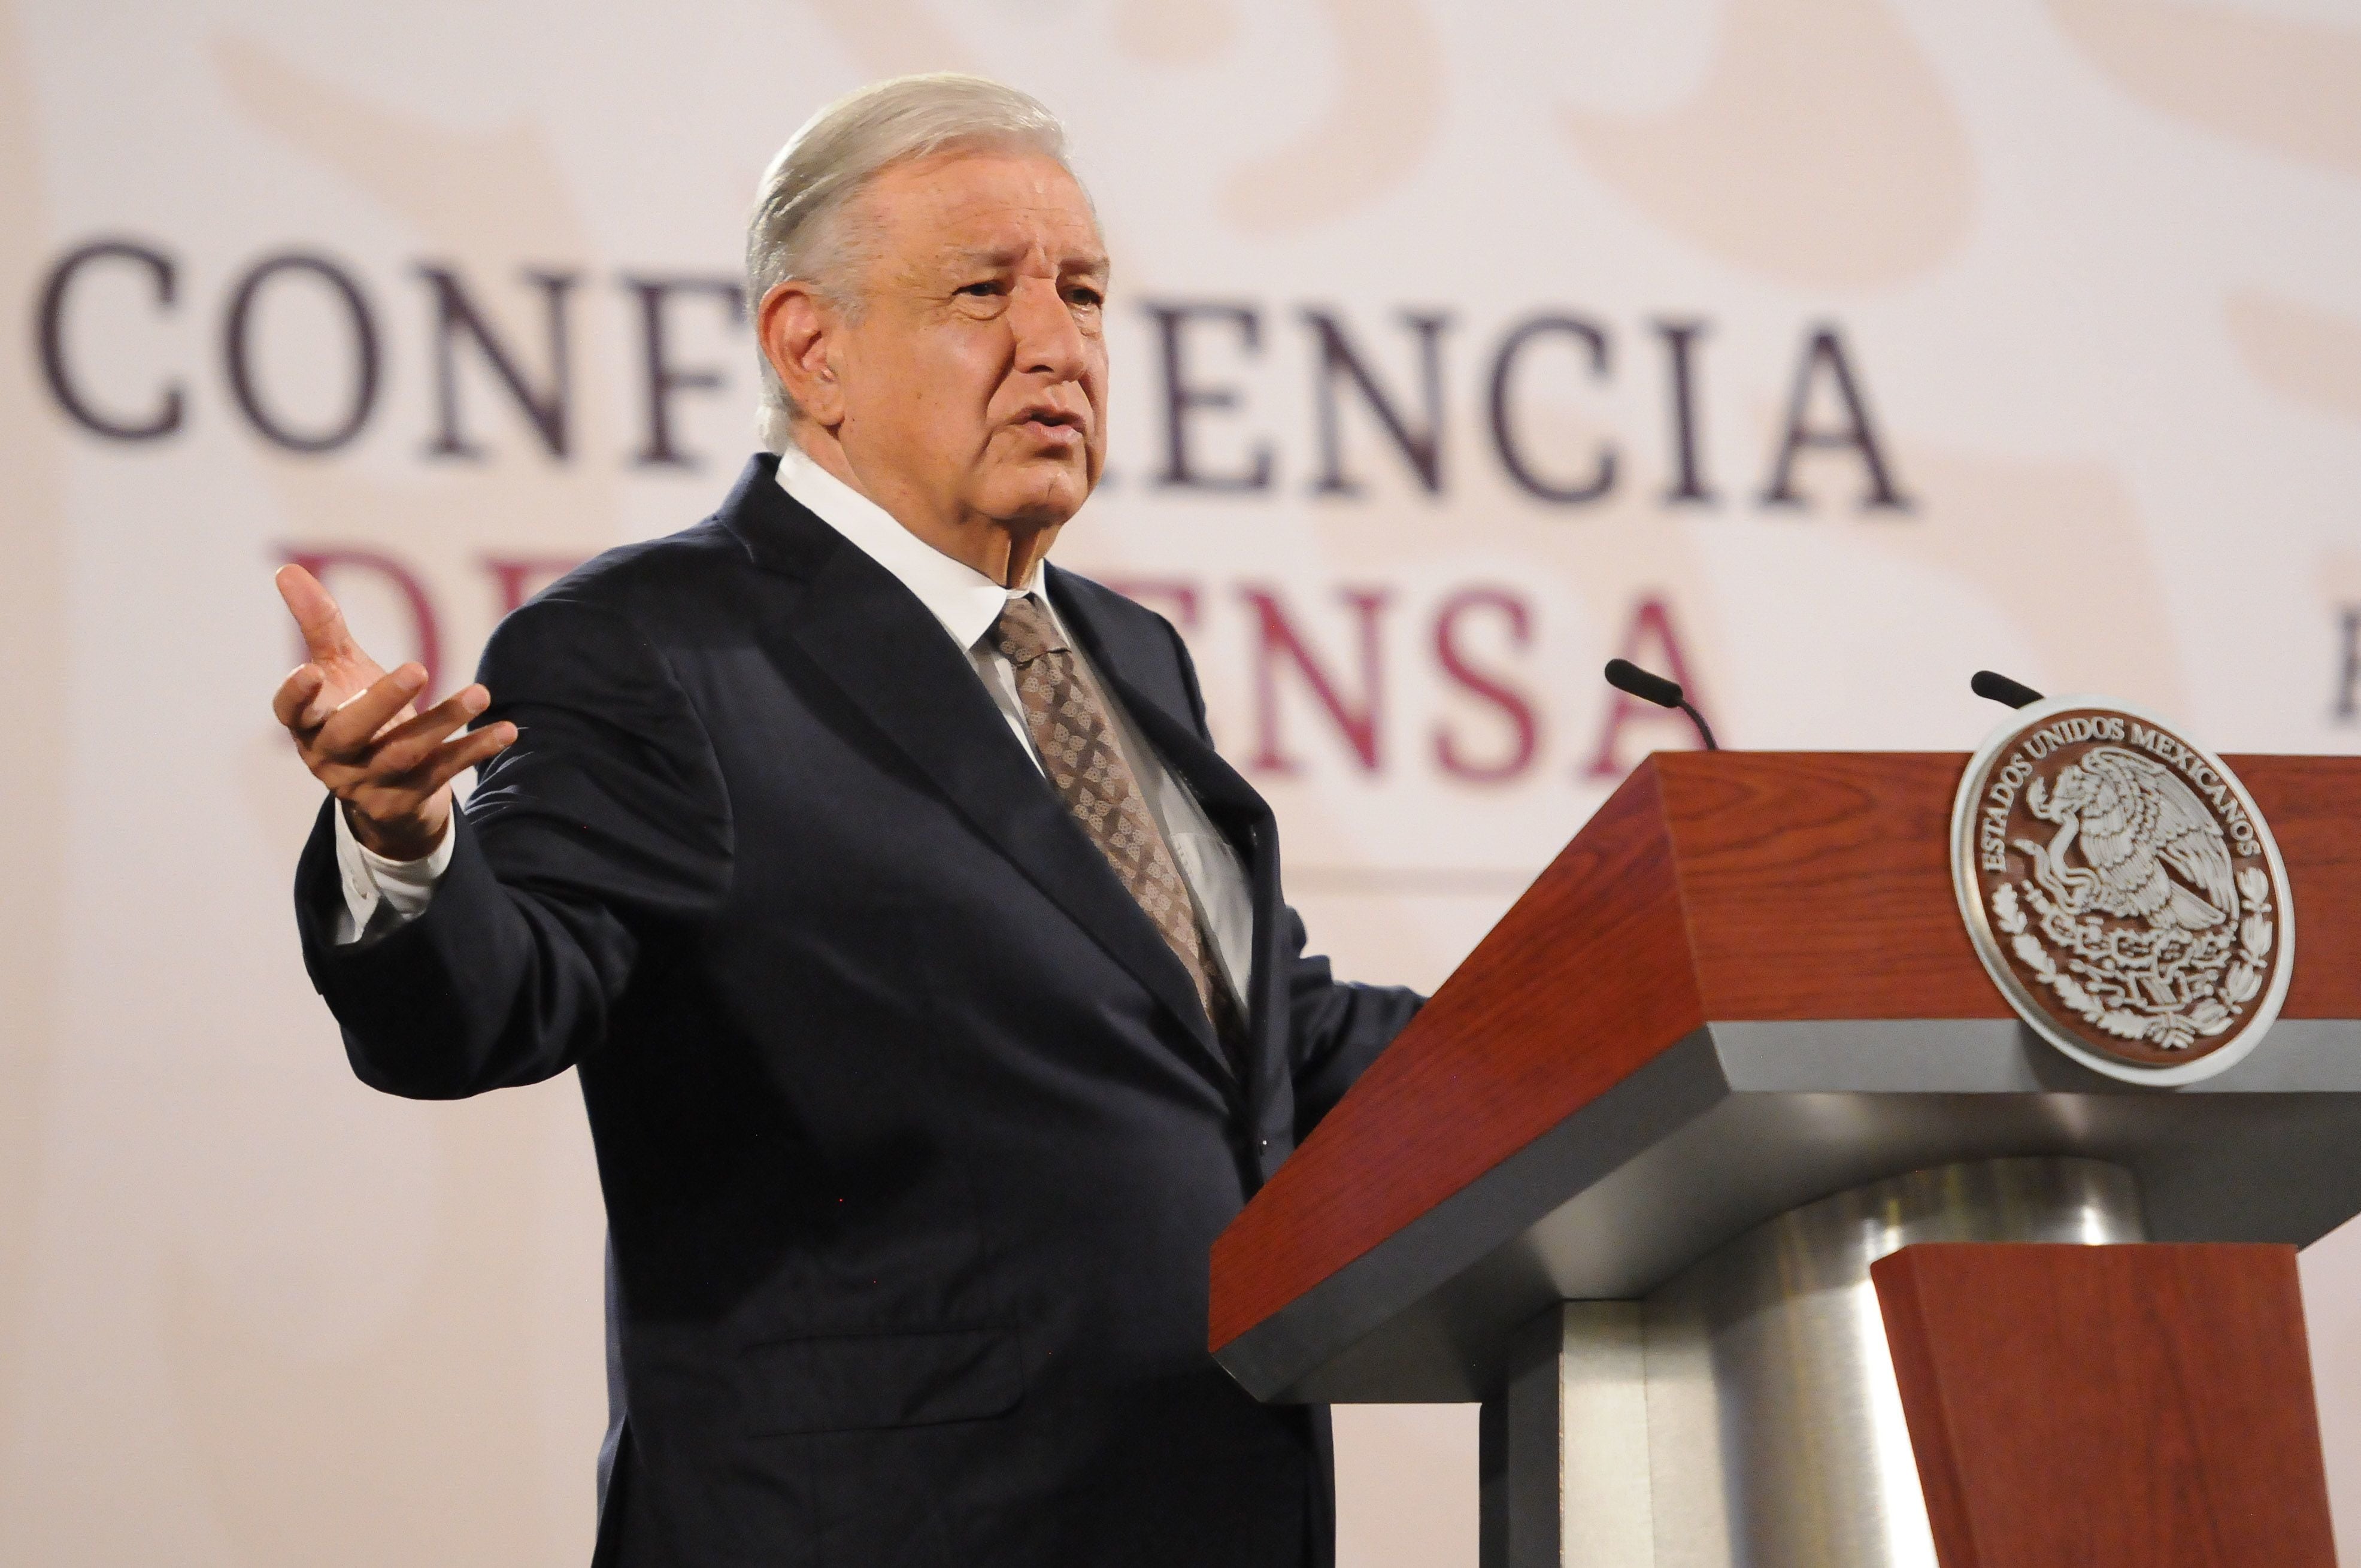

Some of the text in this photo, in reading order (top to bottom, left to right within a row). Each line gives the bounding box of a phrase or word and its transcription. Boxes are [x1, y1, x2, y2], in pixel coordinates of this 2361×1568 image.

[30, 232, 1921, 518] CONFENCIA
[1981, 717, 2262, 871] ESTADOS UNIDOS MEXICANOS
